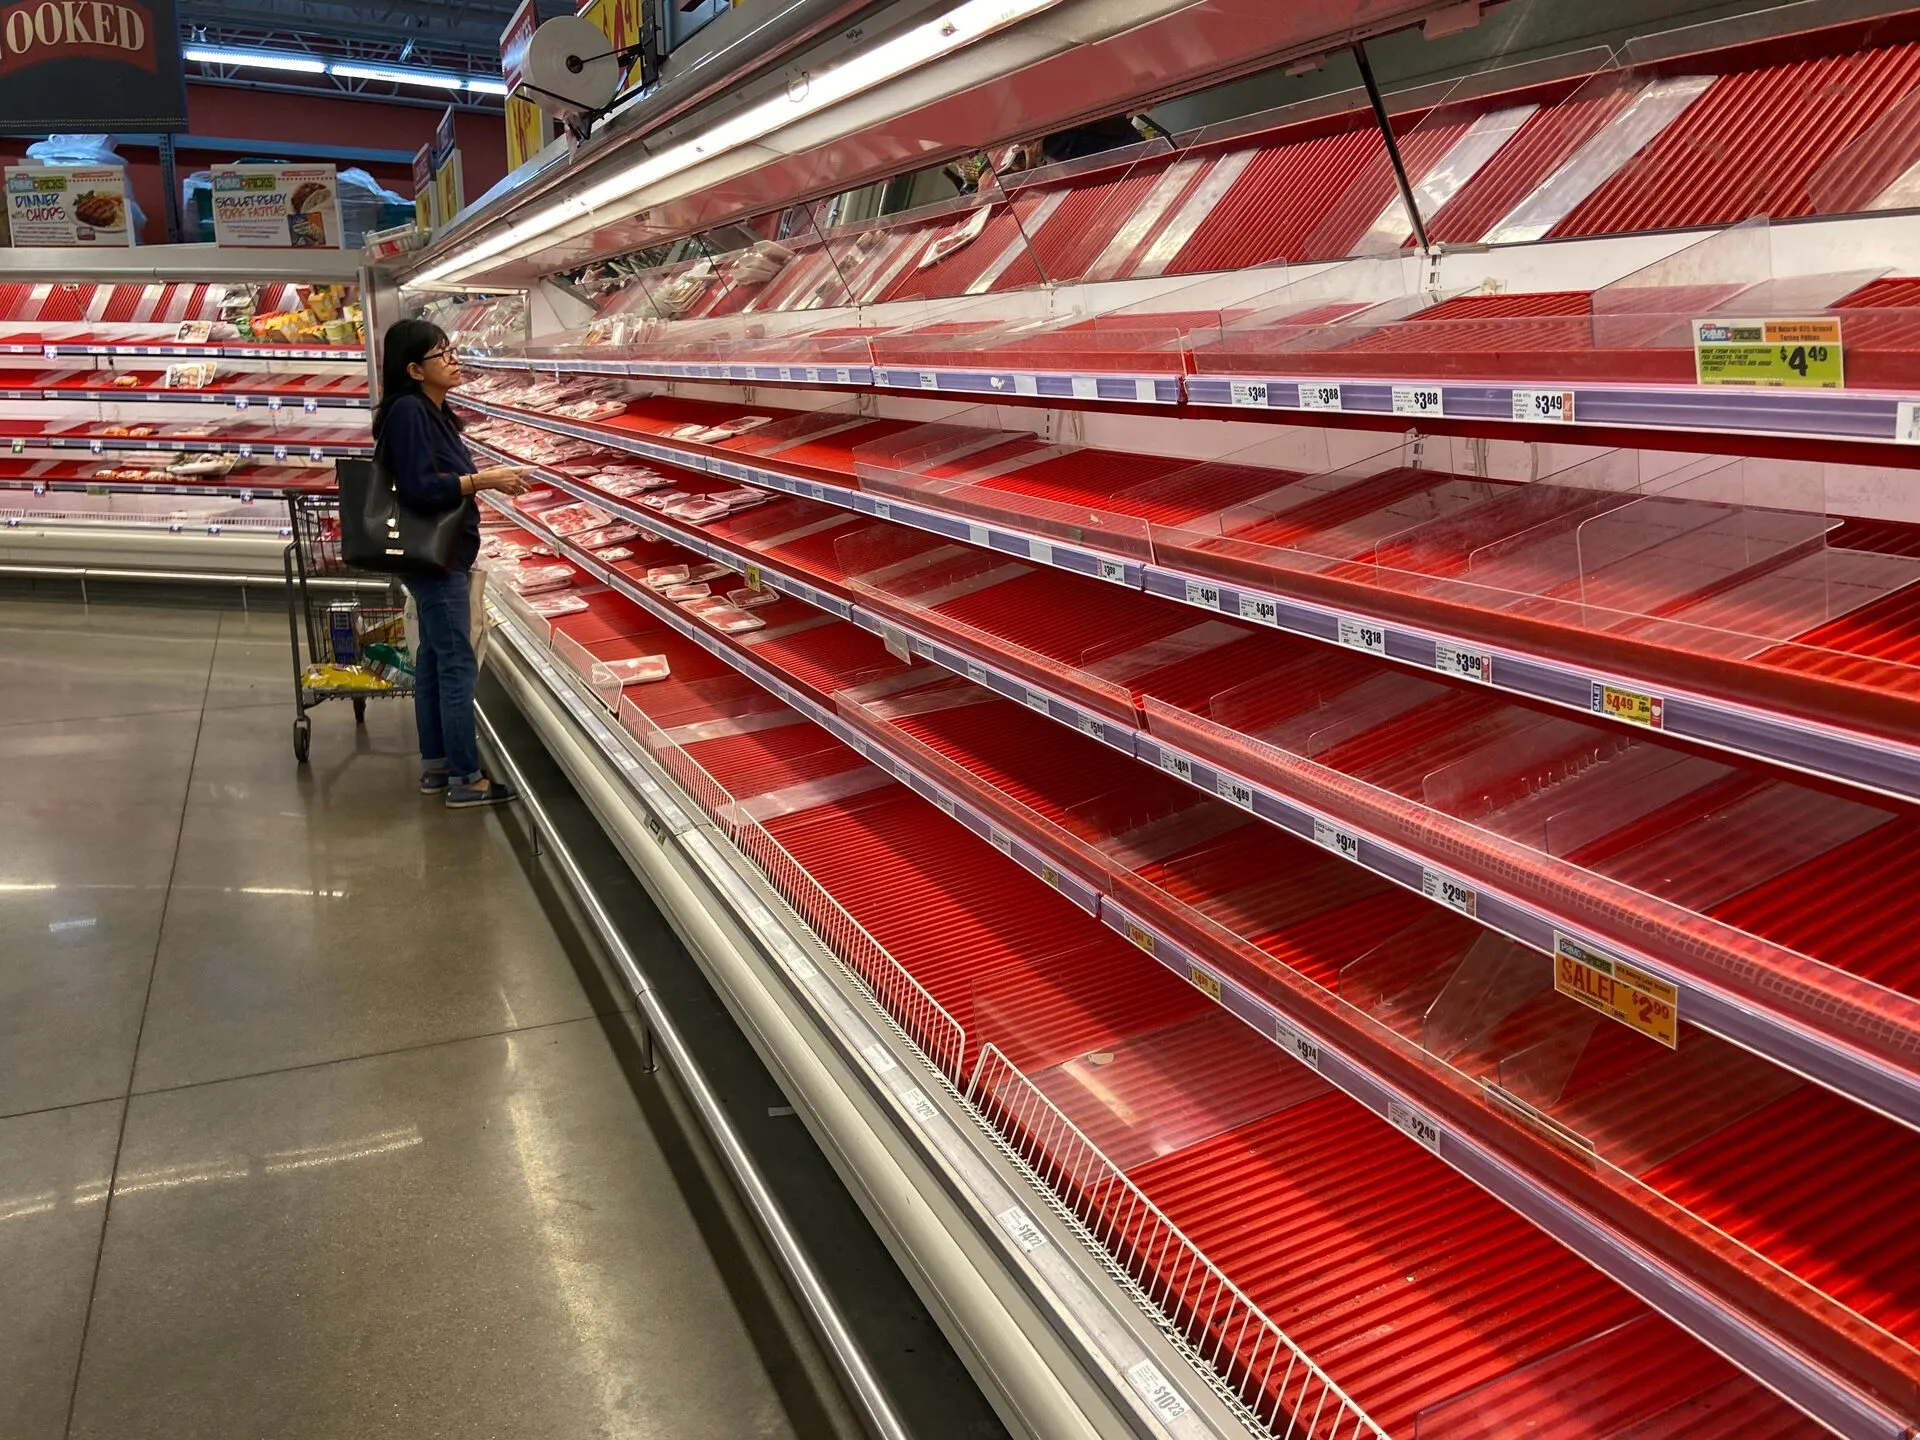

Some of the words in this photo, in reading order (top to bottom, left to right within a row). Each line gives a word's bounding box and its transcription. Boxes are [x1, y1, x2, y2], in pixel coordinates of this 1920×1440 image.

[0, 1, 145, 59] OOKED
[15, 193, 60, 208] DINNER
[26, 206, 66, 222] CHOPS
[1248, 386, 1266, 402] $388
[1318, 388, 1338, 404] $388
[1414, 391, 1438, 409] $388
[1535, 394, 1562, 414] $349
[1360, 628, 1382, 647] $318
[1456, 653, 1481, 672] $399
[1606, 693, 1634, 712] $449
[1442, 882, 1466, 902] $299
[1561, 957, 1616, 1006] SALE!
[1632, 991, 1670, 1024] $299
[1411, 1116, 1436, 1142] $249
[1154, 1385, 1185, 1417] $1023
